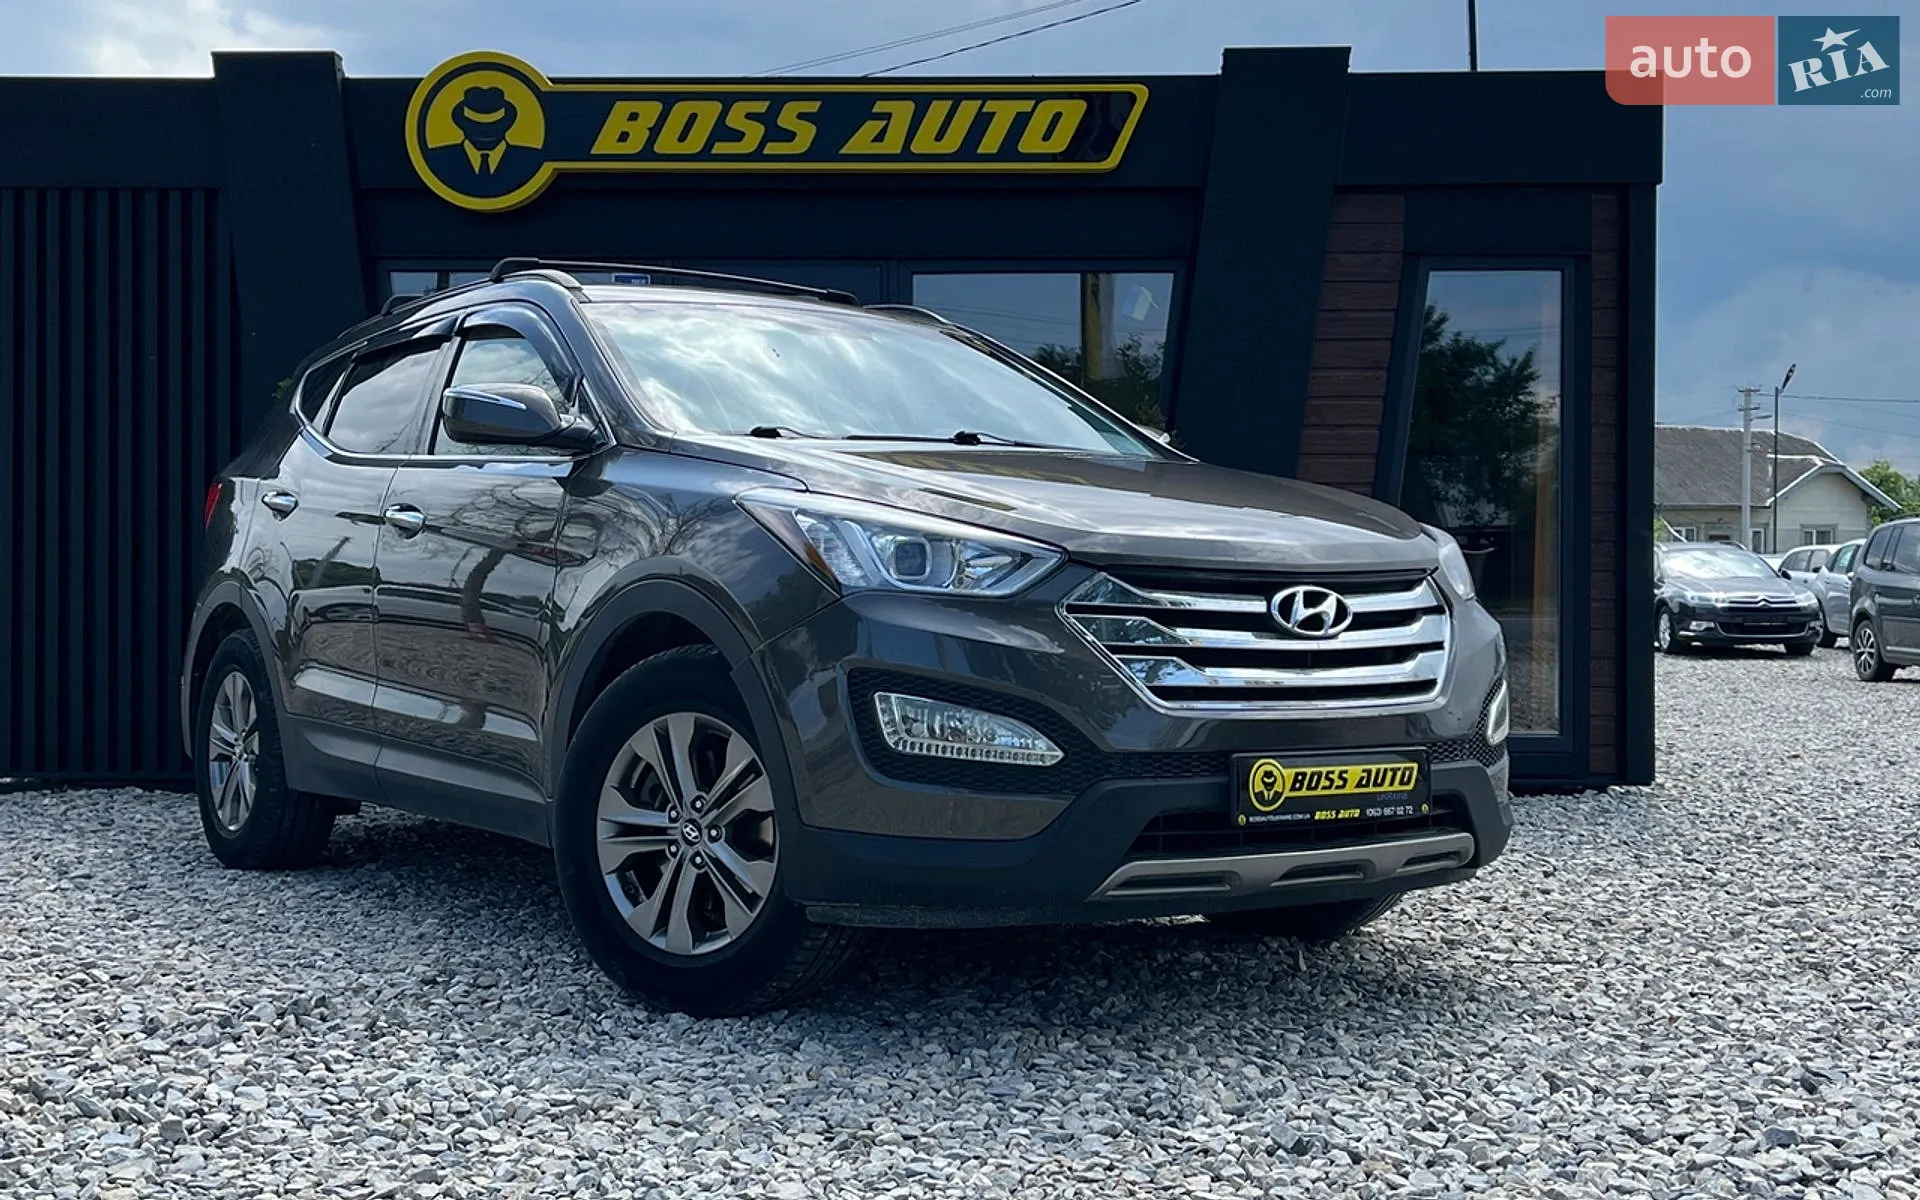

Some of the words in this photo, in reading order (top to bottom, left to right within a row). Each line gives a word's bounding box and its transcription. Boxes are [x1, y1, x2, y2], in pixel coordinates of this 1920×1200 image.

[590, 99, 822, 155] BOSS
[839, 99, 1089, 155] AUTO
[1288, 769, 1349, 792] BOSS
[1354, 766, 1416, 789] AUTO
[1314, 810, 1337, 820] BOSS
[1337, 808, 1361, 819] AUTO
